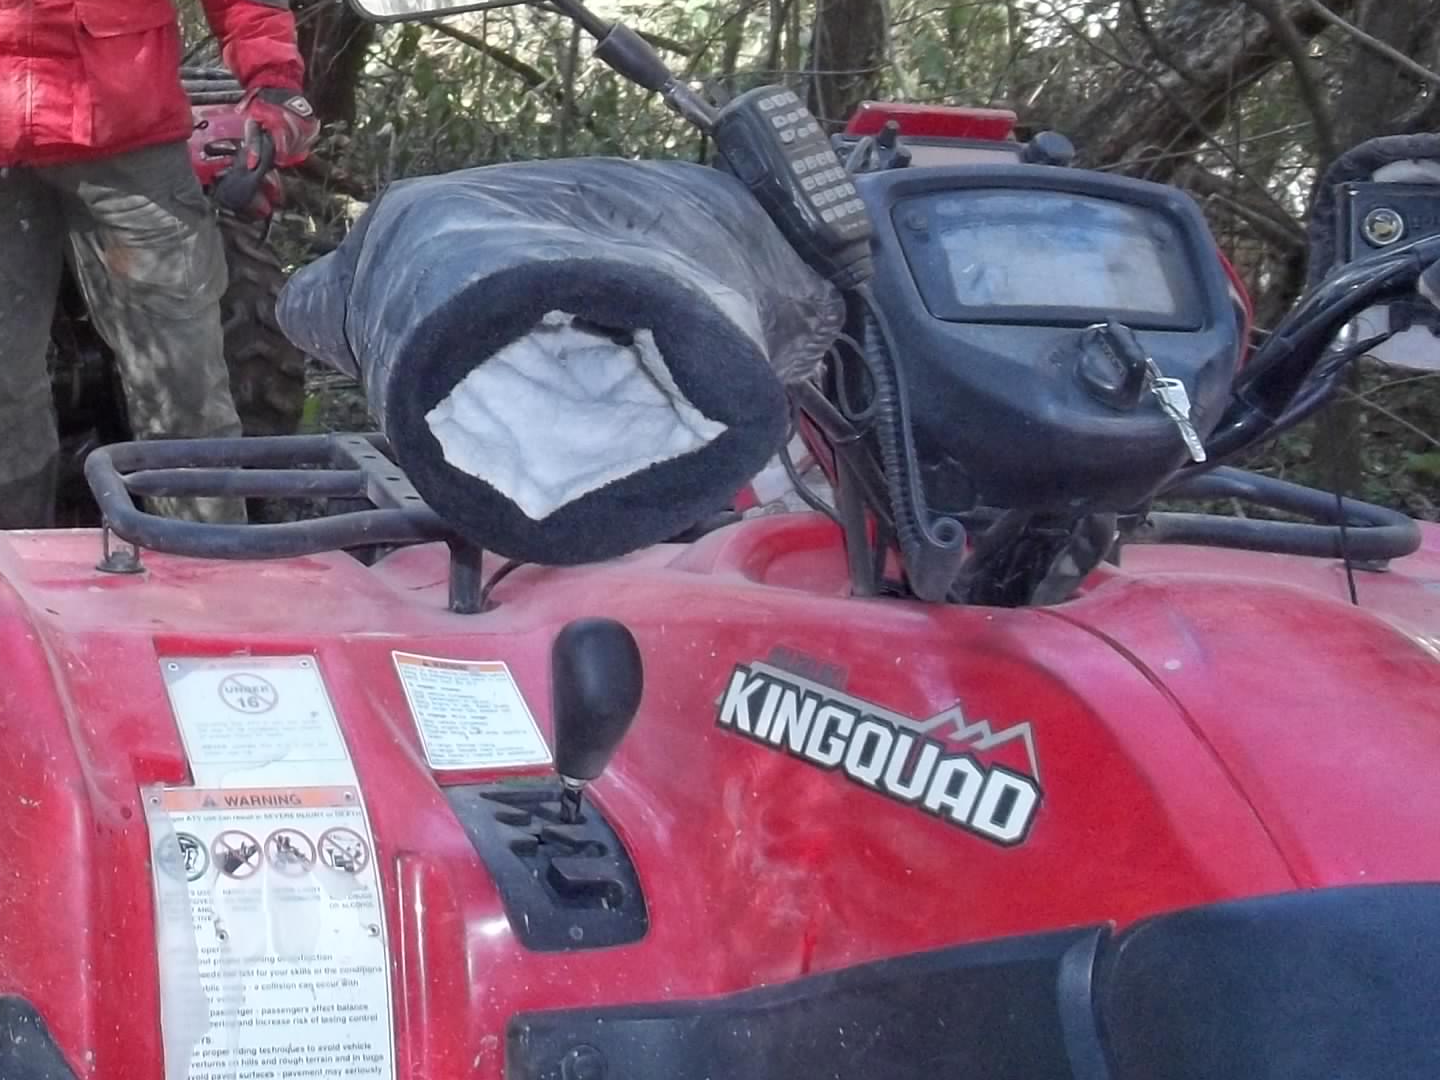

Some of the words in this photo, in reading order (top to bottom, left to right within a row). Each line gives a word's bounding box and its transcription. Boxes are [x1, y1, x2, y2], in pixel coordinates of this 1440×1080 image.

[236, 696, 260, 708] 16
[718, 668, 1040, 843] KINGQUAD
[223, 794, 303, 808] WARNING
[256, 968, 267, 976] for
[270, 968, 288, 978] your
[290, 967, 312, 976] skills
[261, 982, 297, 991] collision
[261, 1006, 309, 1016] passengers
[337, 1003, 369, 1011] balance
[255, 1017, 291, 1025] increase
[293, 1016, 308, 1024] risk
[310, 1015, 319, 1023] of
[321, 1015, 347, 1025] losing
[349, 1012, 379, 1022] control
[202, 1049, 230, 1058] proper
[307, 1044, 316, 1052] to
[318, 1043, 340, 1052] avoid
[343, 1042, 372, 1050] vehicle
[241, 1057, 259, 1066] hills
[261, 1056, 277, 1065] and
[279, 1056, 304, 1065] rough
[306, 1055, 333, 1064] terrain
[335, 1054, 351, 1062] and
[353, 1053, 361, 1061] in
[239, 1070, 275, 1080] surfaces
[282, 1069, 323, 1079] pavement
[325, 1067, 342, 1077] may
[345, 1065, 383, 1075] seriously
